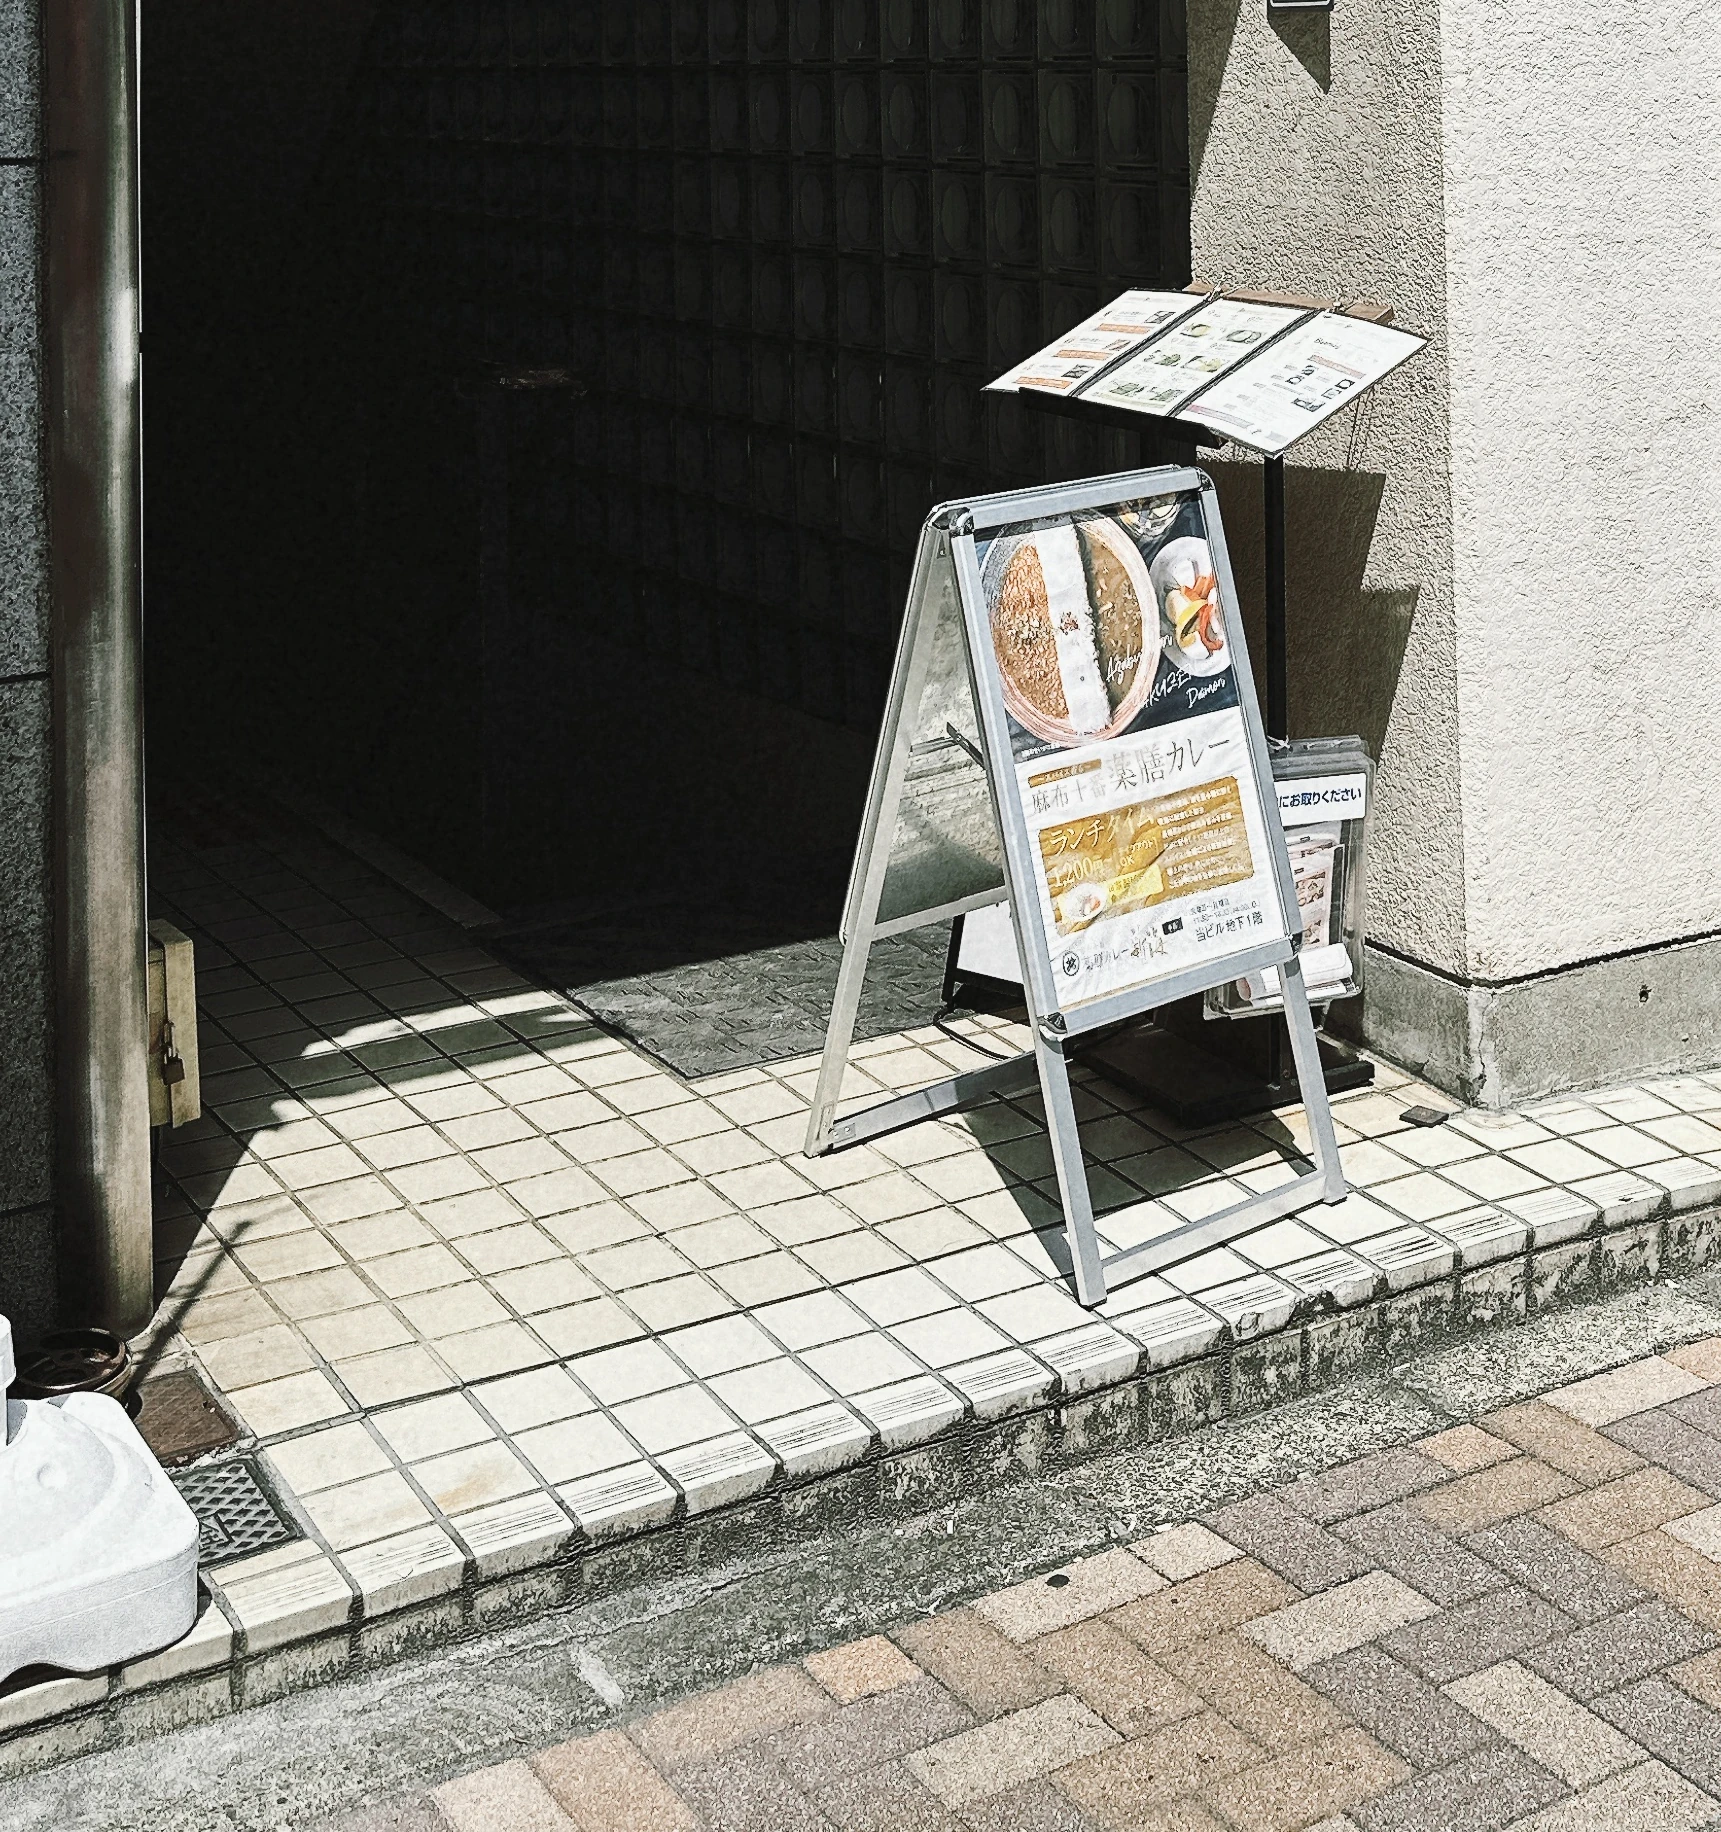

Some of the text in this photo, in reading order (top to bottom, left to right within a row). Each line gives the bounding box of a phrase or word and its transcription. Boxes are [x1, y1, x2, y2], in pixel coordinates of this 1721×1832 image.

[1050, 807, 1155, 856] ランチタイム
[1195, 910, 1263, 942] 当ビル地下1階
